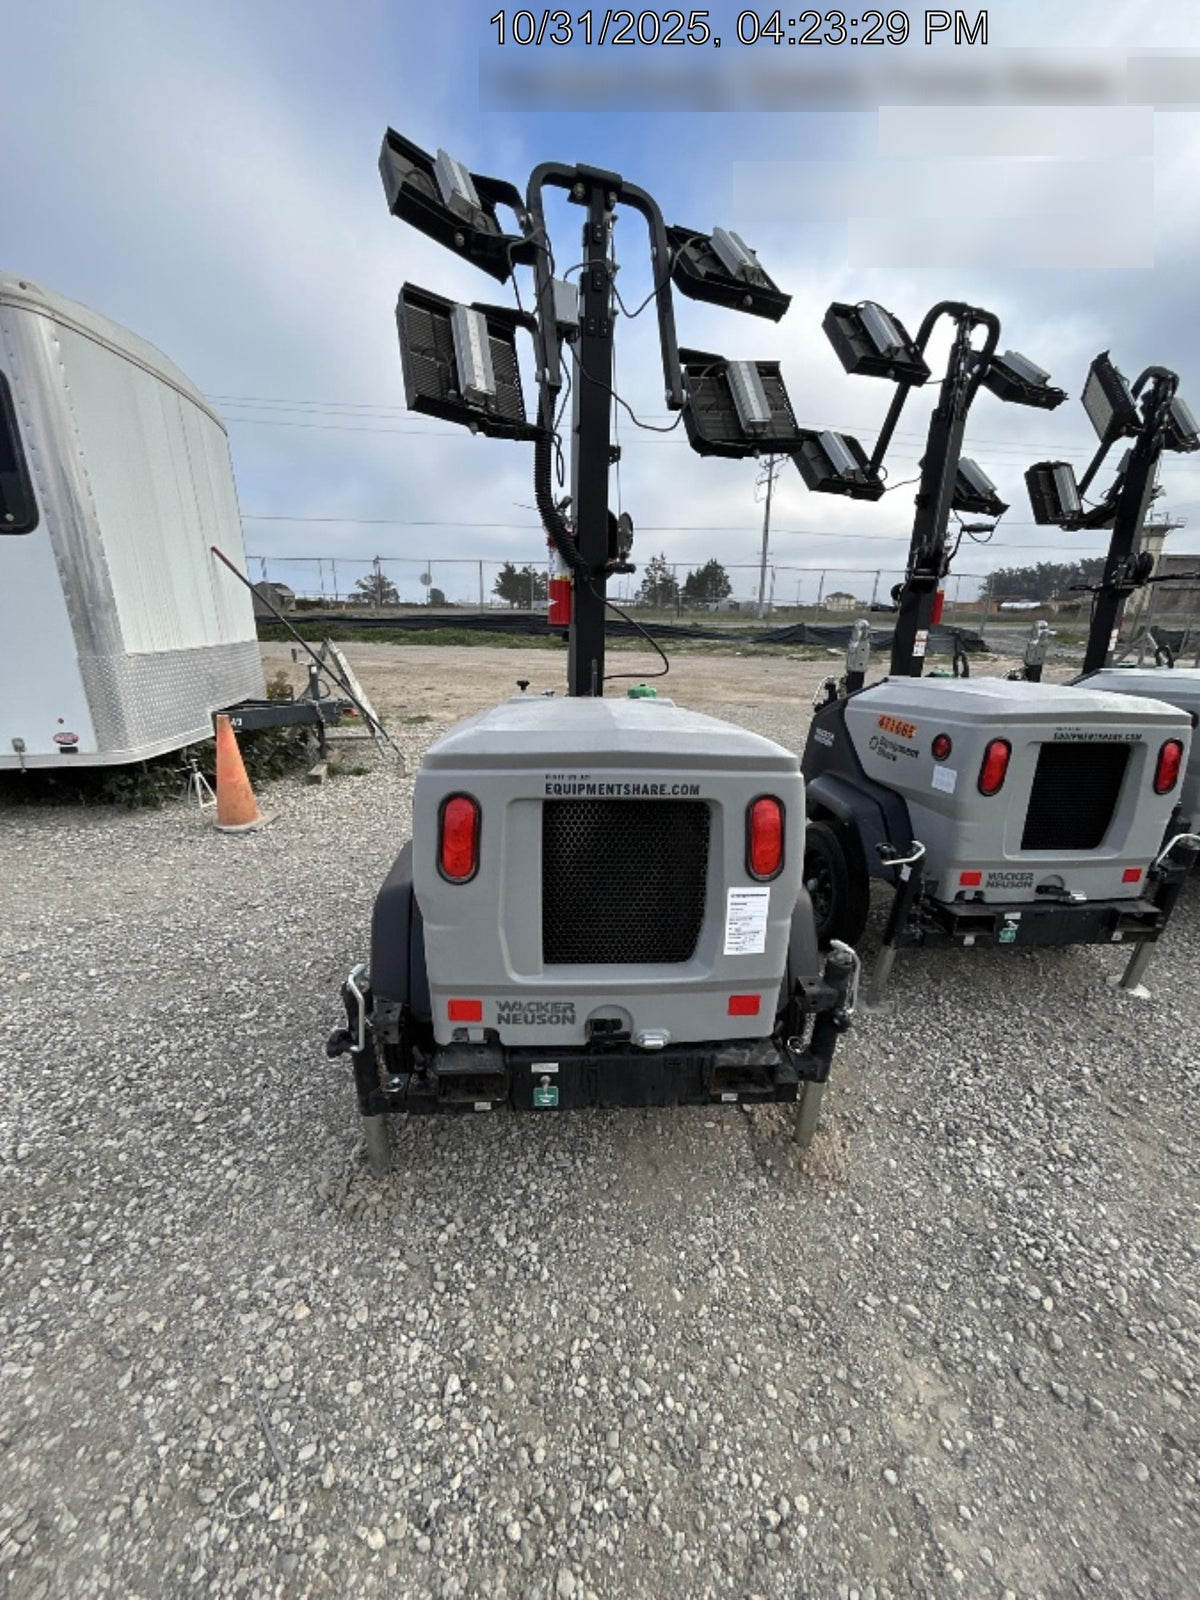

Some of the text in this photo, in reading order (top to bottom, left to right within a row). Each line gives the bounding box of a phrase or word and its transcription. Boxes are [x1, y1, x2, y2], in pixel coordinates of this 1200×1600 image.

[545, 783, 700, 796] EQUIPMENTSHARE.COM
[496, 1000, 576, 1014] WACKER
[497, 1013, 576, 1025] NEUSON
